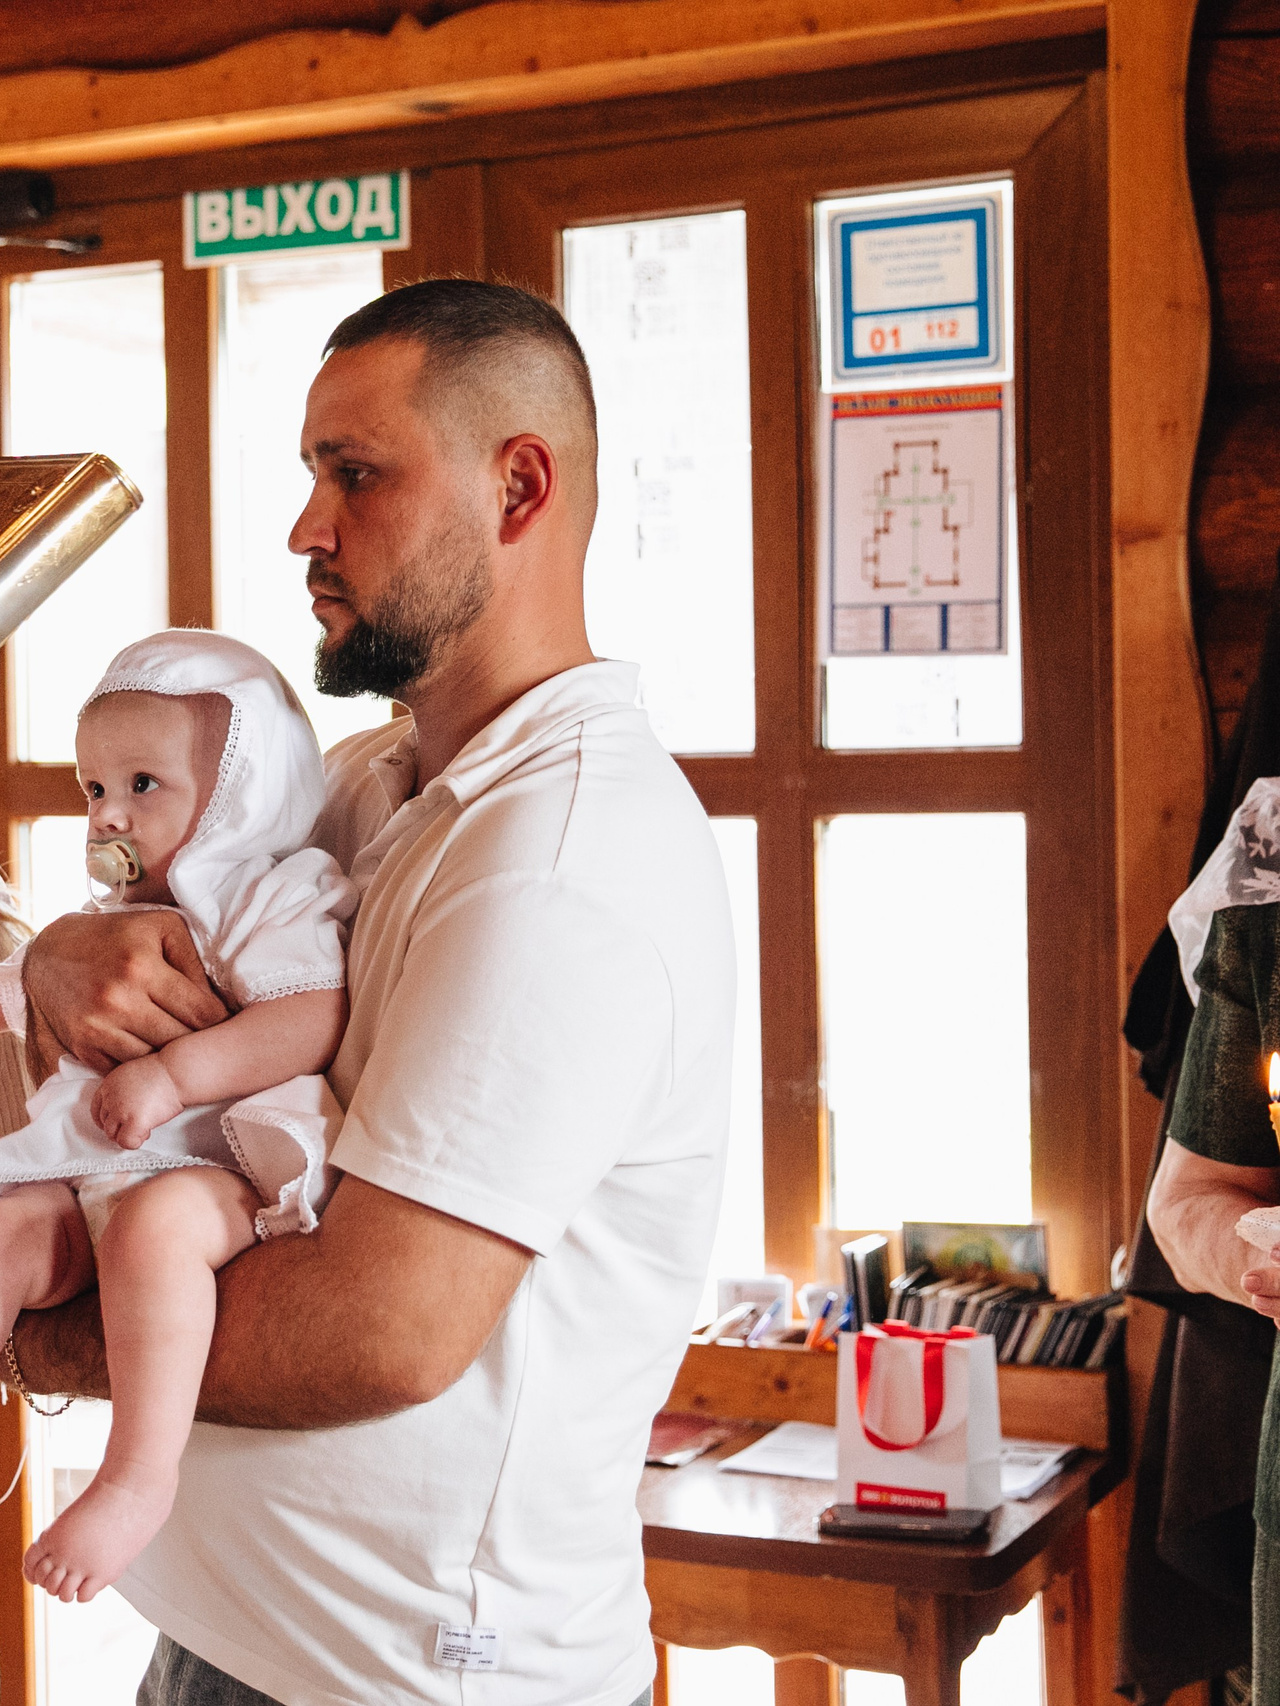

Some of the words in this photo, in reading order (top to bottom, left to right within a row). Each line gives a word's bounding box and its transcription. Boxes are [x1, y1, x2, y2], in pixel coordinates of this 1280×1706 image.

[197, 174, 396, 243] ВЫХОД
[869, 325, 901, 353] 01
[926, 319, 959, 339] 112
